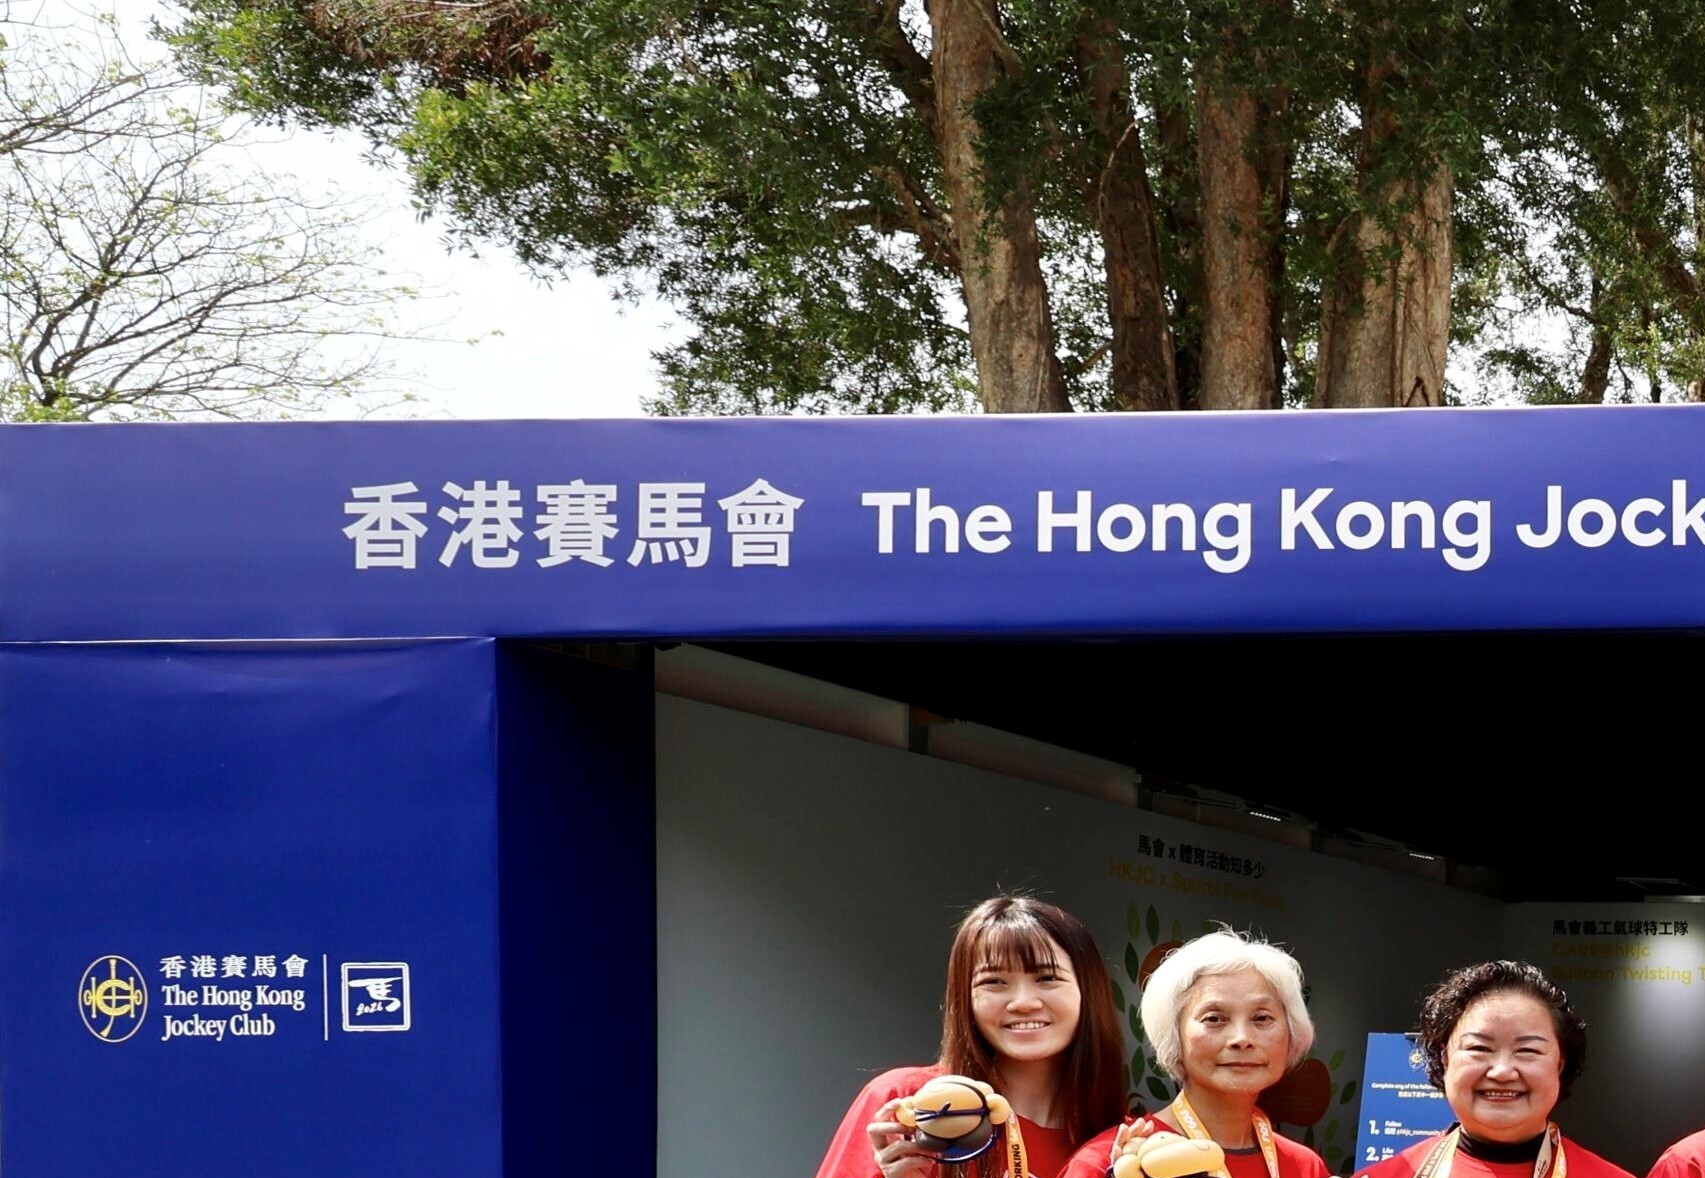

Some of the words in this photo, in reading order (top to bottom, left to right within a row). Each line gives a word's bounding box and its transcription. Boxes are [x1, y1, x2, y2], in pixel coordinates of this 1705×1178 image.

[342, 478, 805, 569] 香港賽馬會
[862, 488, 1012, 555] The
[1038, 490, 1252, 573] Hong
[1281, 487, 1492, 571] Kong
[1109, 858, 1153, 885] HKJC
[160, 954, 308, 978] 香港賽馬會
[1620, 967, 1691, 985] Twisting
[161, 984, 197, 1006] The
[202, 984, 252, 1011] Hong
[256, 984, 304, 1011] Kong
[161, 1014, 227, 1042] Jockey
[230, 1013, 275, 1036] Club
[1369, 1120, 1380, 1135] 1.
[1366, 1147, 1379, 1161] 2.
